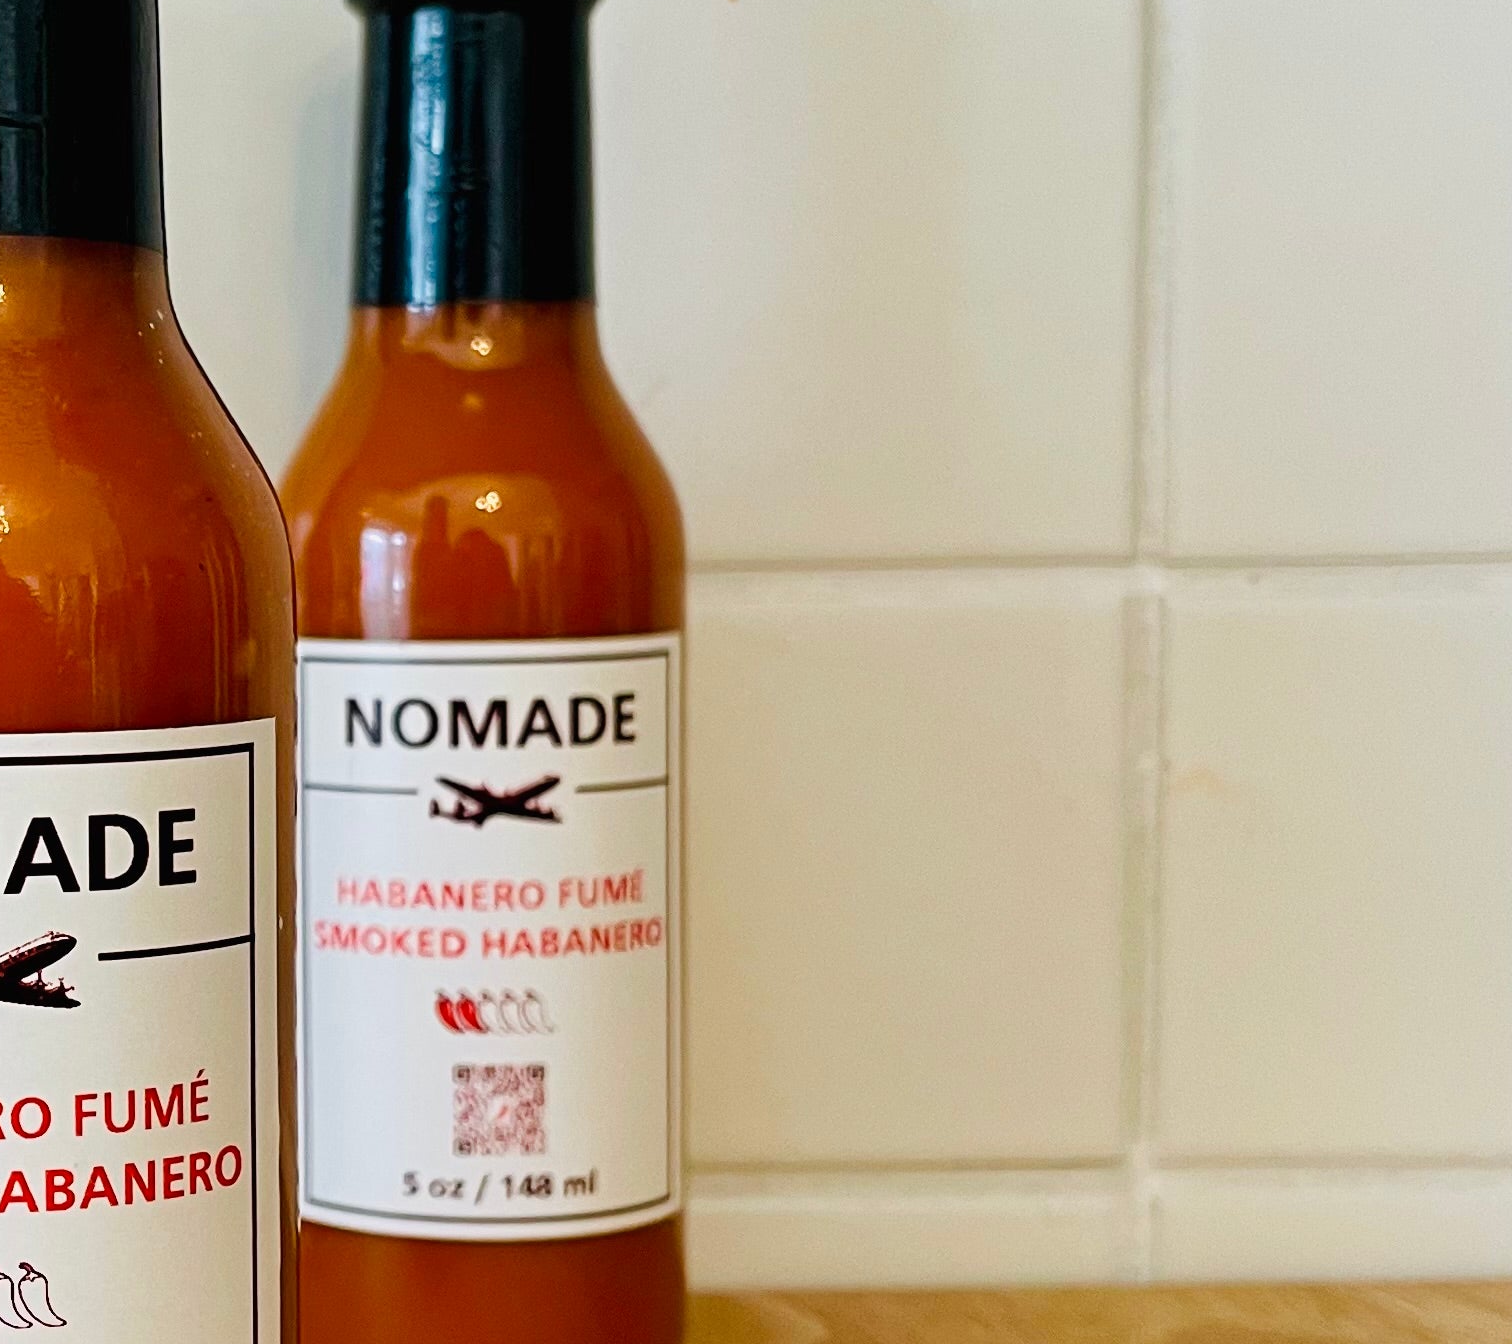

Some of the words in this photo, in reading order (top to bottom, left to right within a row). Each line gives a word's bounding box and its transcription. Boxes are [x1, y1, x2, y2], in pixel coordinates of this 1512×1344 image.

[347, 692, 636, 748] NOMADE
[339, 880, 547, 911] HABANERO
[560, 869, 643, 907] FUMÉ
[316, 921, 468, 959] SMOKED
[482, 917, 663, 959] HABANERO
[75, 1069, 209, 1136] FUMÉ
[404, 1172, 419, 1195] 5
[429, 1179, 464, 1199] oz
[504, 1175, 553, 1197] 148
[564, 1170, 597, 1195] ml
